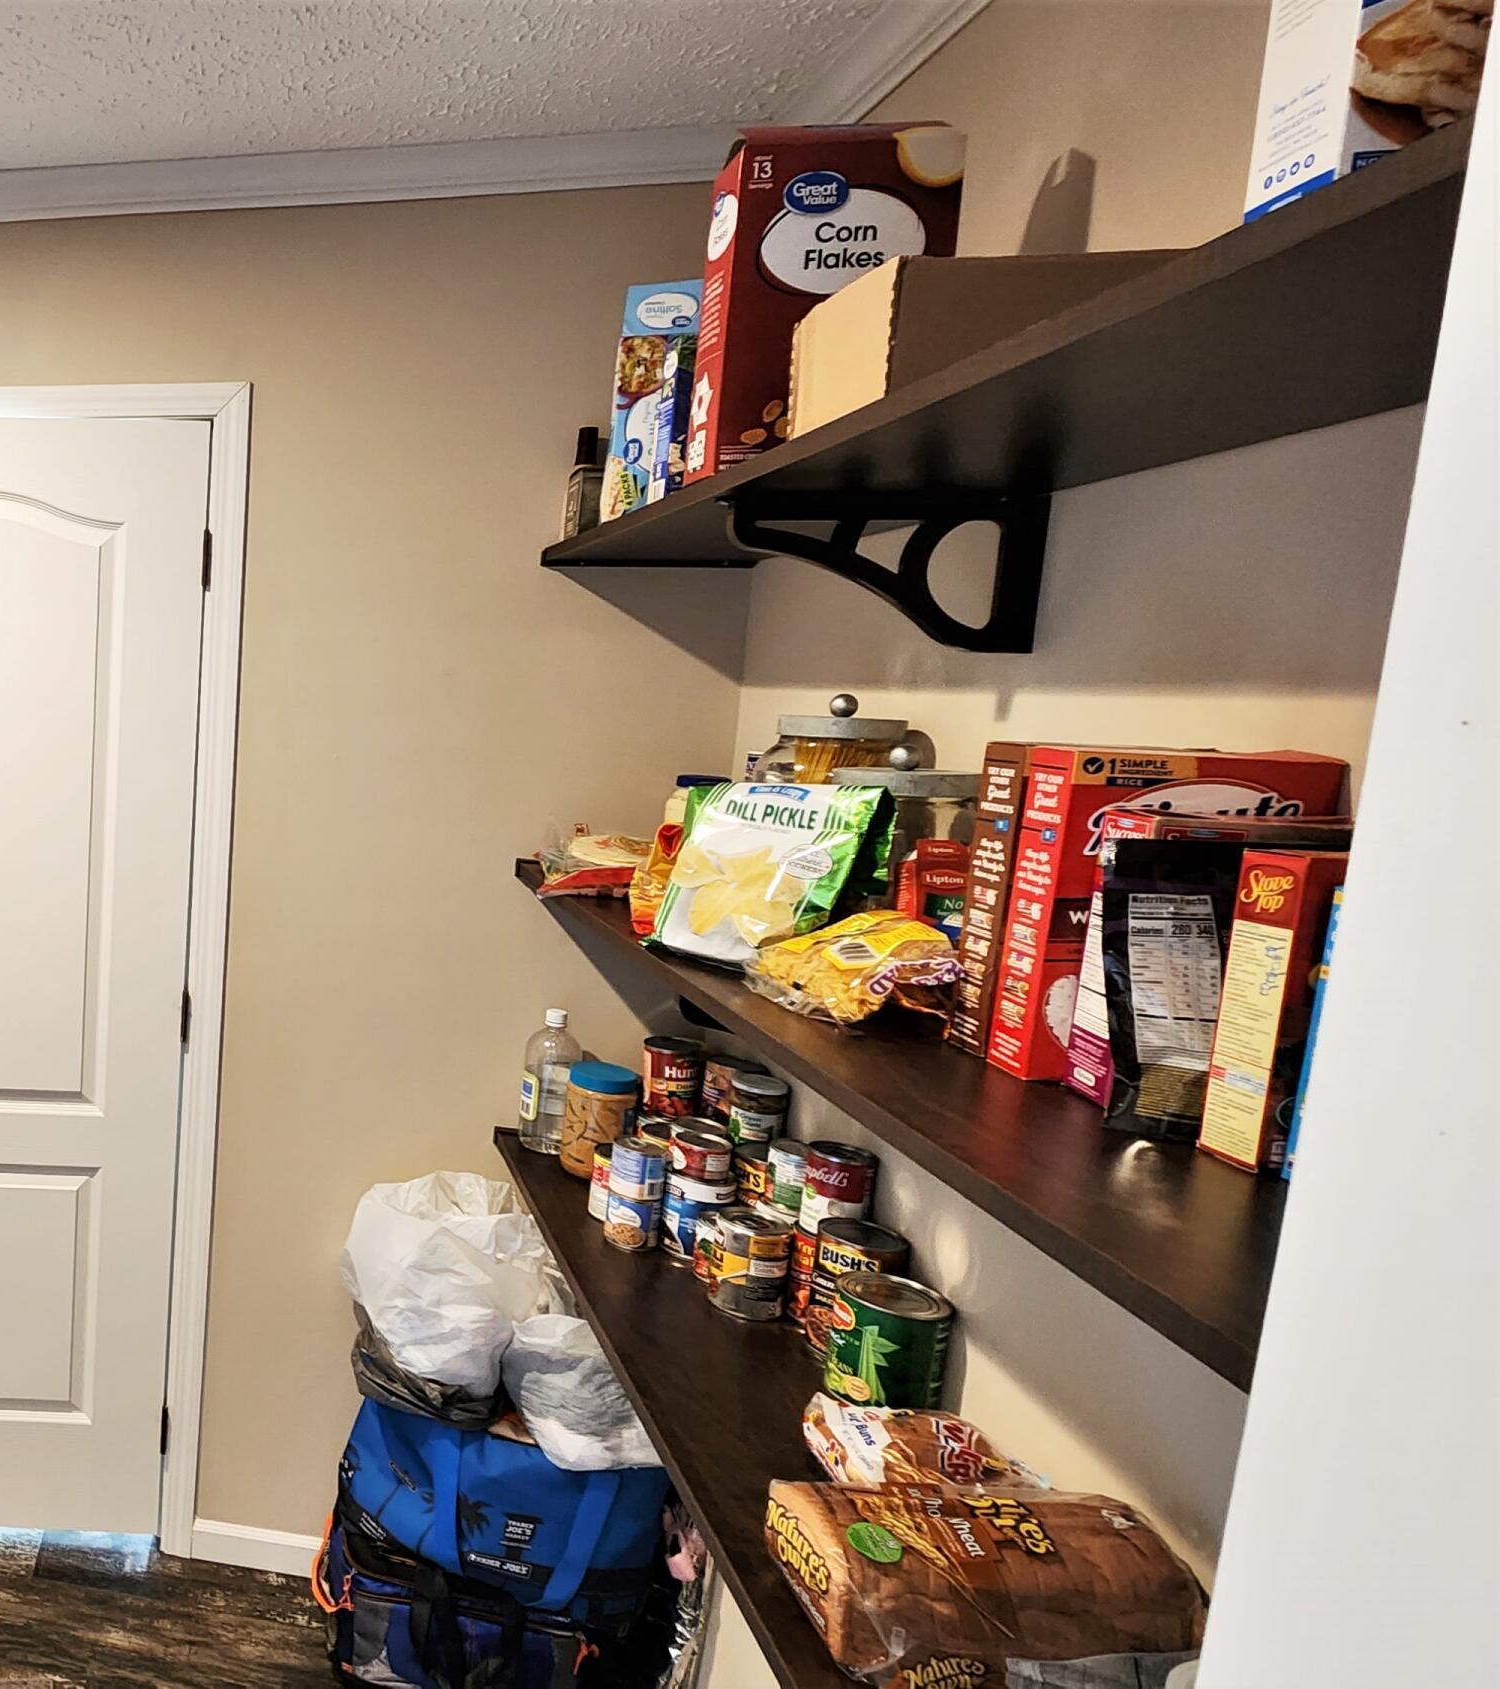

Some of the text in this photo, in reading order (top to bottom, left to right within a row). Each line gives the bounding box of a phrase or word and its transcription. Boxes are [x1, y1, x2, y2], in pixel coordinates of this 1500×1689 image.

[751, 161, 773, 179] 13
[792, 182, 838, 197] Great
[802, 194, 837, 205] Value
[814, 221, 878, 244] Corn
[802, 247, 885, 272] Flakes
[622, 473, 632, 495] PACKS
[1108, 758, 1169, 775] 1 SIMPLE
[1115, 778, 1144, 787] RICE
[725, 799, 819, 830] DILL PICKLE
[925, 873, 964, 885] Lipton
[1239, 869, 1295, 903] Stove
[943, 898, 964, 910] No
[1254, 893, 1285, 913] Top
[821, 1245, 878, 1273] BUSH'S
[855, 1423, 877, 1447] Buns
[767, 1500, 831, 1591] Nature's
[777, 1534, 814, 1588] Own
